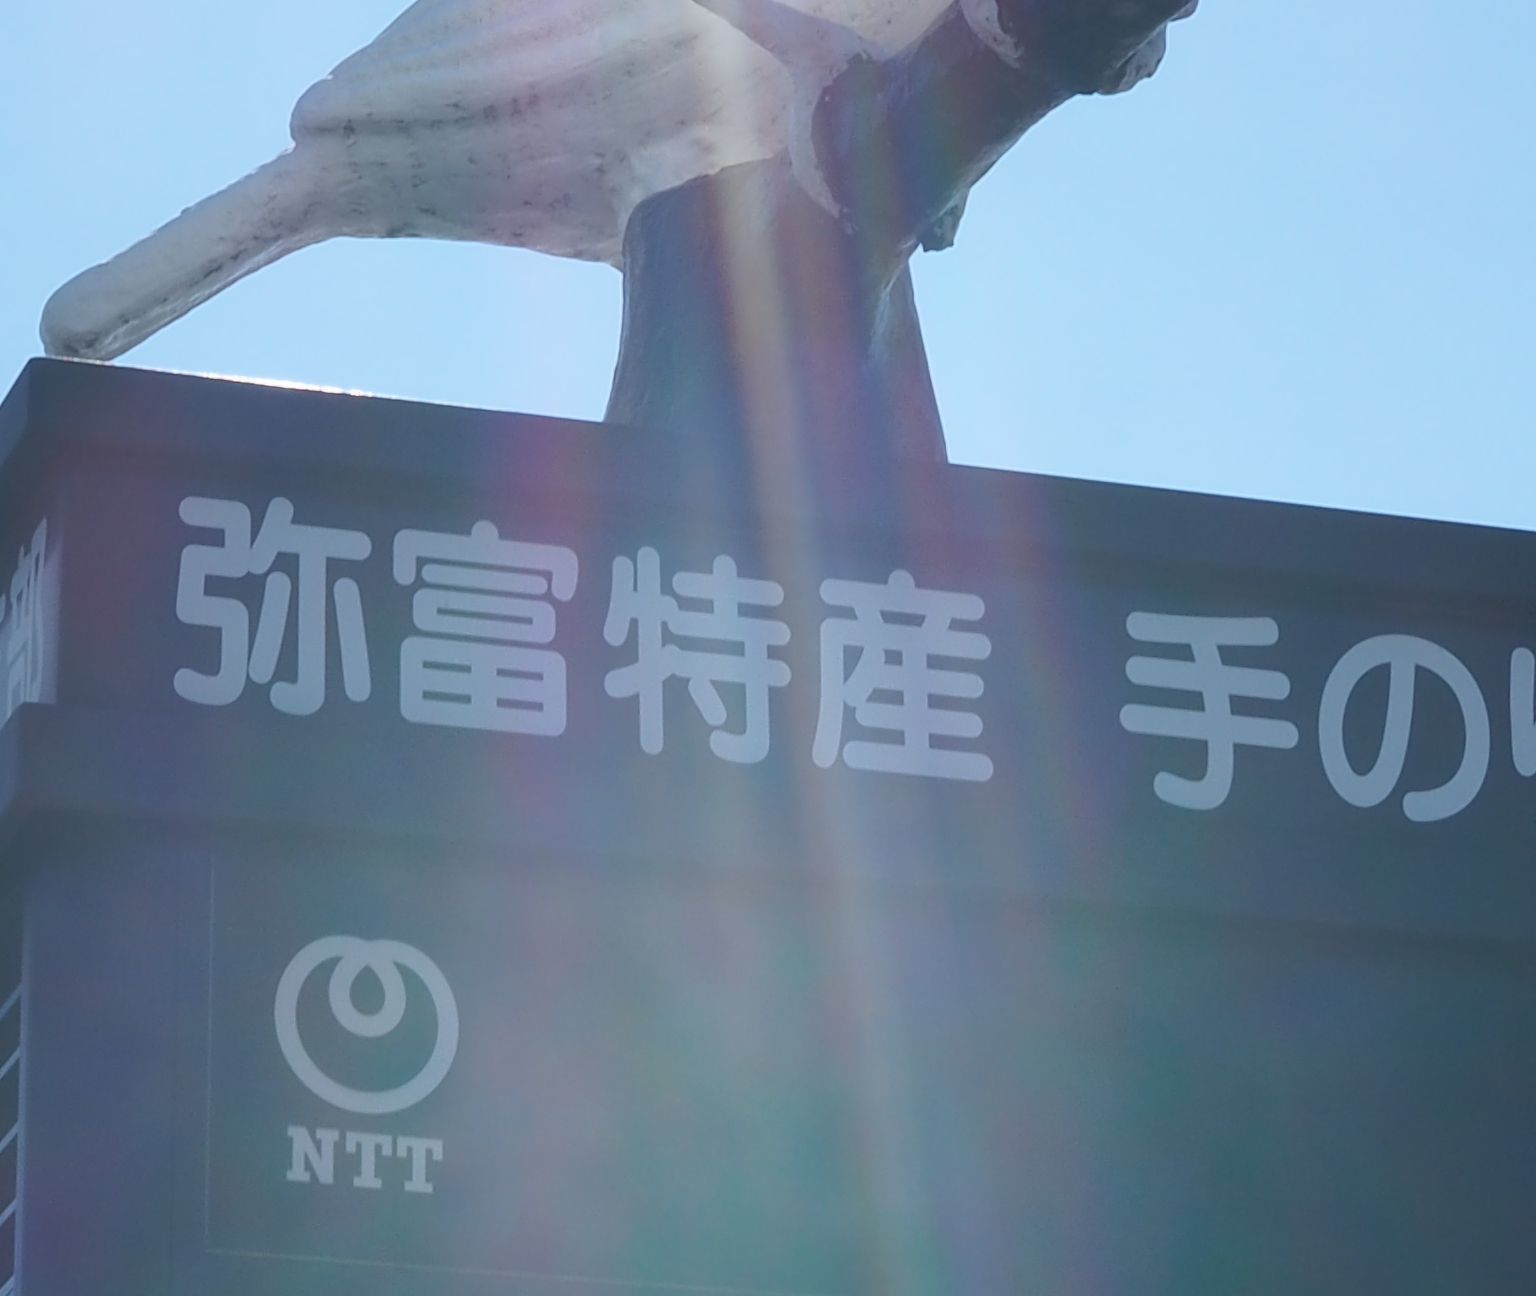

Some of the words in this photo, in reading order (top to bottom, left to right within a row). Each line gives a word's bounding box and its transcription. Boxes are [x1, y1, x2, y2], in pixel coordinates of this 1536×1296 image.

[173, 495, 995, 783] 弥富特産
[286, 1124, 444, 1194] NTT
